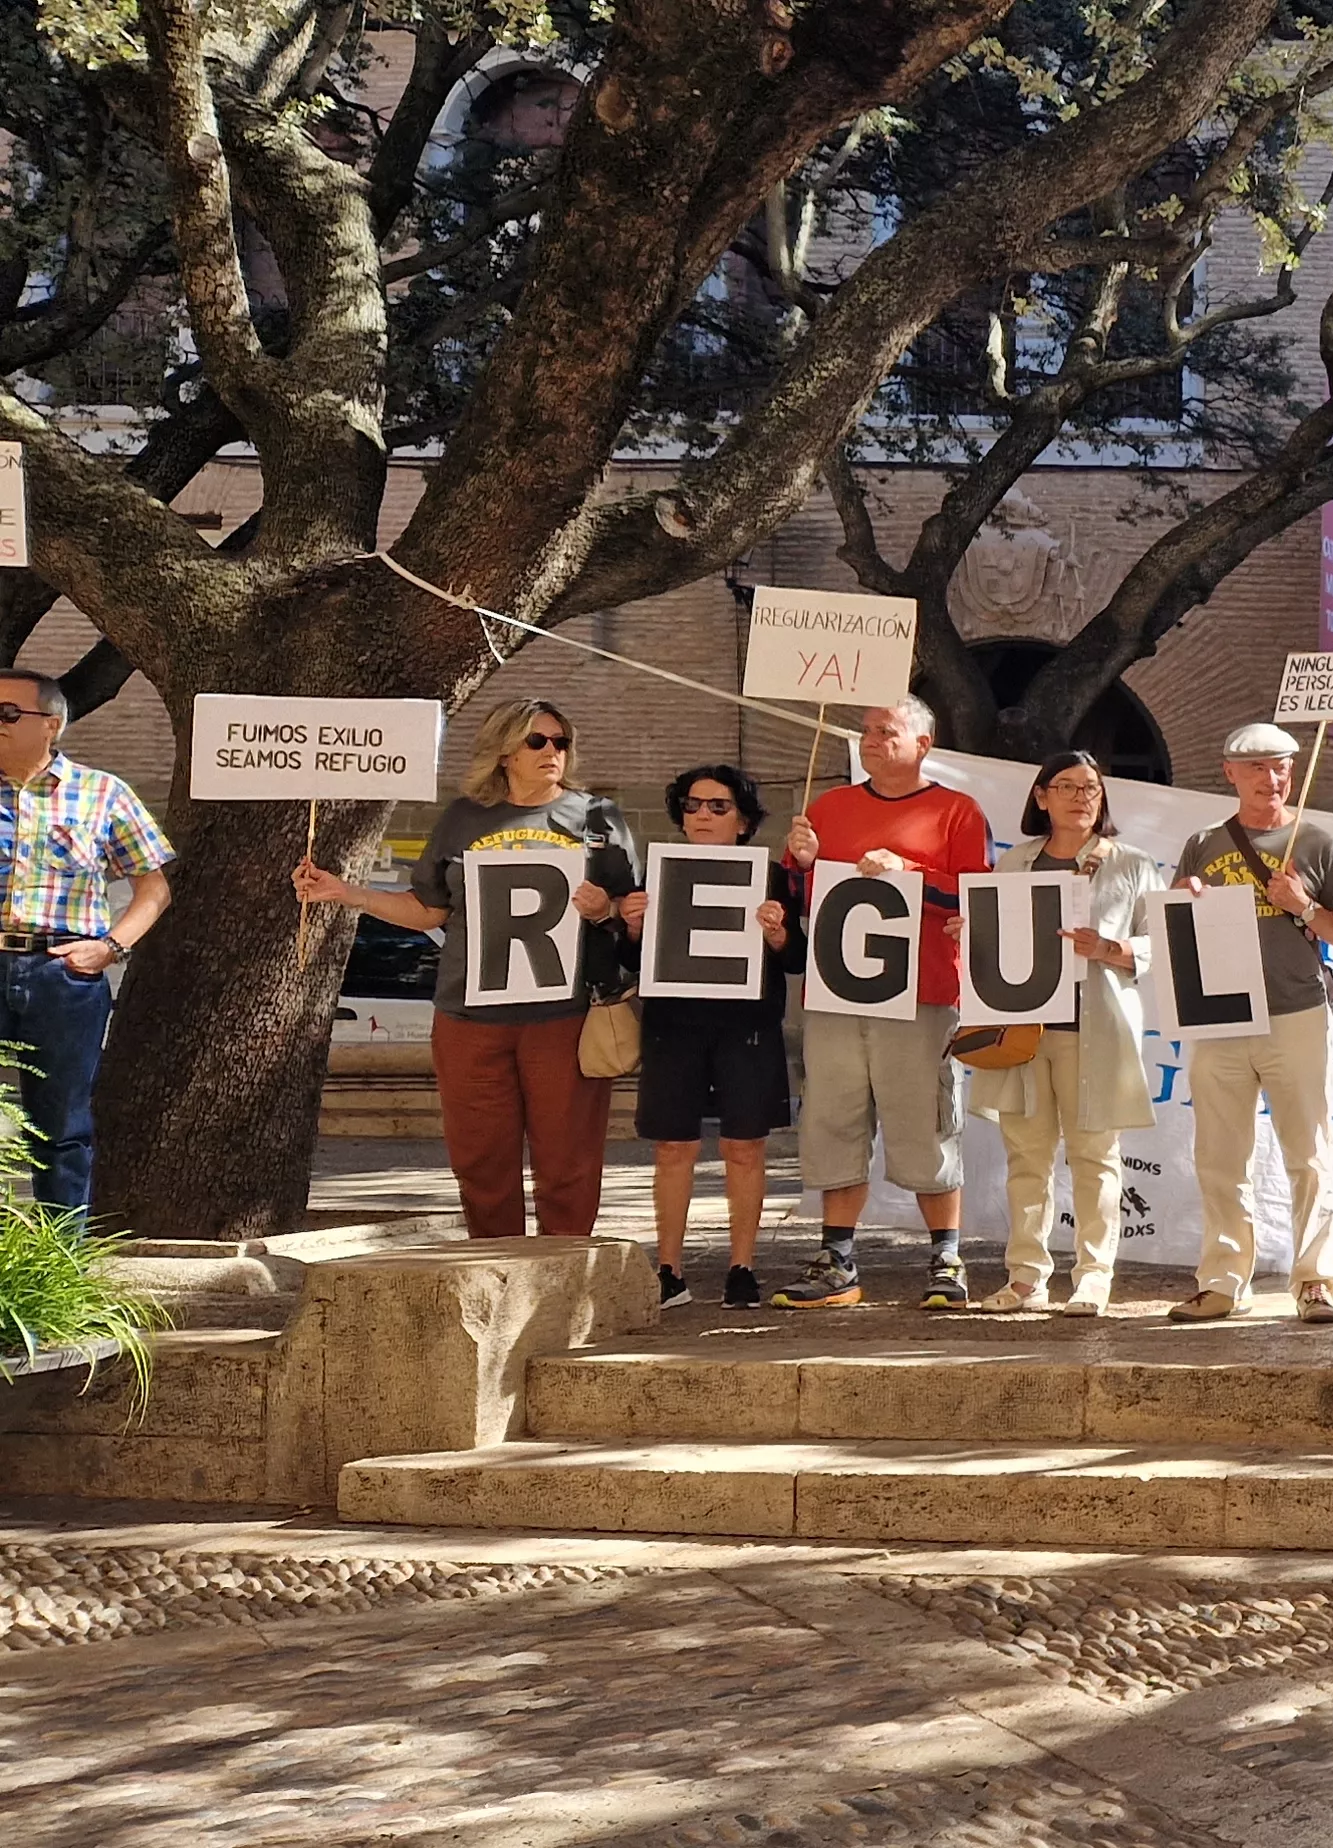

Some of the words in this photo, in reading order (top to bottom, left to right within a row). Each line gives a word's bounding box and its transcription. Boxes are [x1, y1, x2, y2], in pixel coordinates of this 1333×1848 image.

[797, 650, 860, 692] YA!
[1278, 695, 1299, 711] ES
[227, 723, 307, 744] FUIMOS
[318, 726, 383, 747] EXILIO
[216, 748, 302, 770] SEAMOS
[314, 752, 406, 774] REFUGIO
